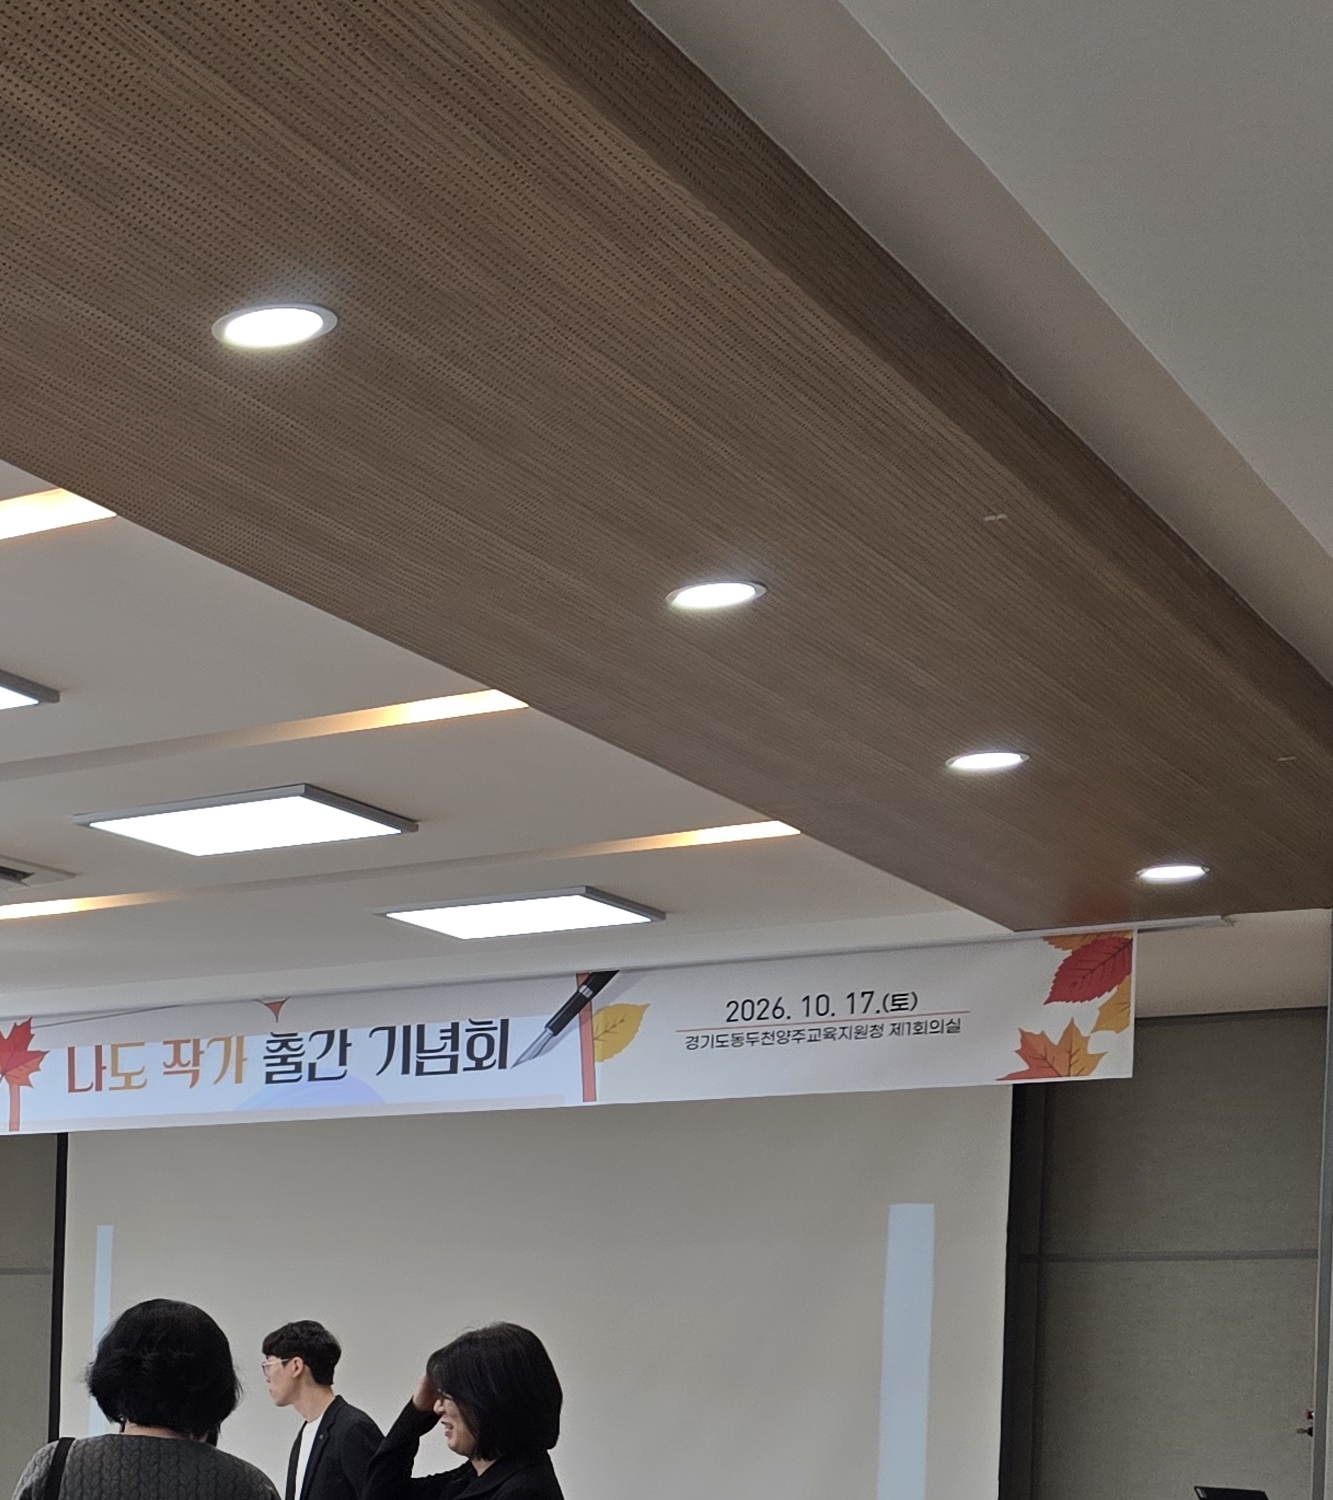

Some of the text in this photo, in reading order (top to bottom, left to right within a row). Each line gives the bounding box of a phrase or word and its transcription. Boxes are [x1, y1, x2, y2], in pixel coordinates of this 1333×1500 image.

[725, 990, 918, 1022] 2026. 10. 17.(토)
[685, 1017, 962, 1050] 경기도동두천양주교육지원청 제1회의실
[67, 1018, 511, 1093] 나도 작가 출간 기념회
